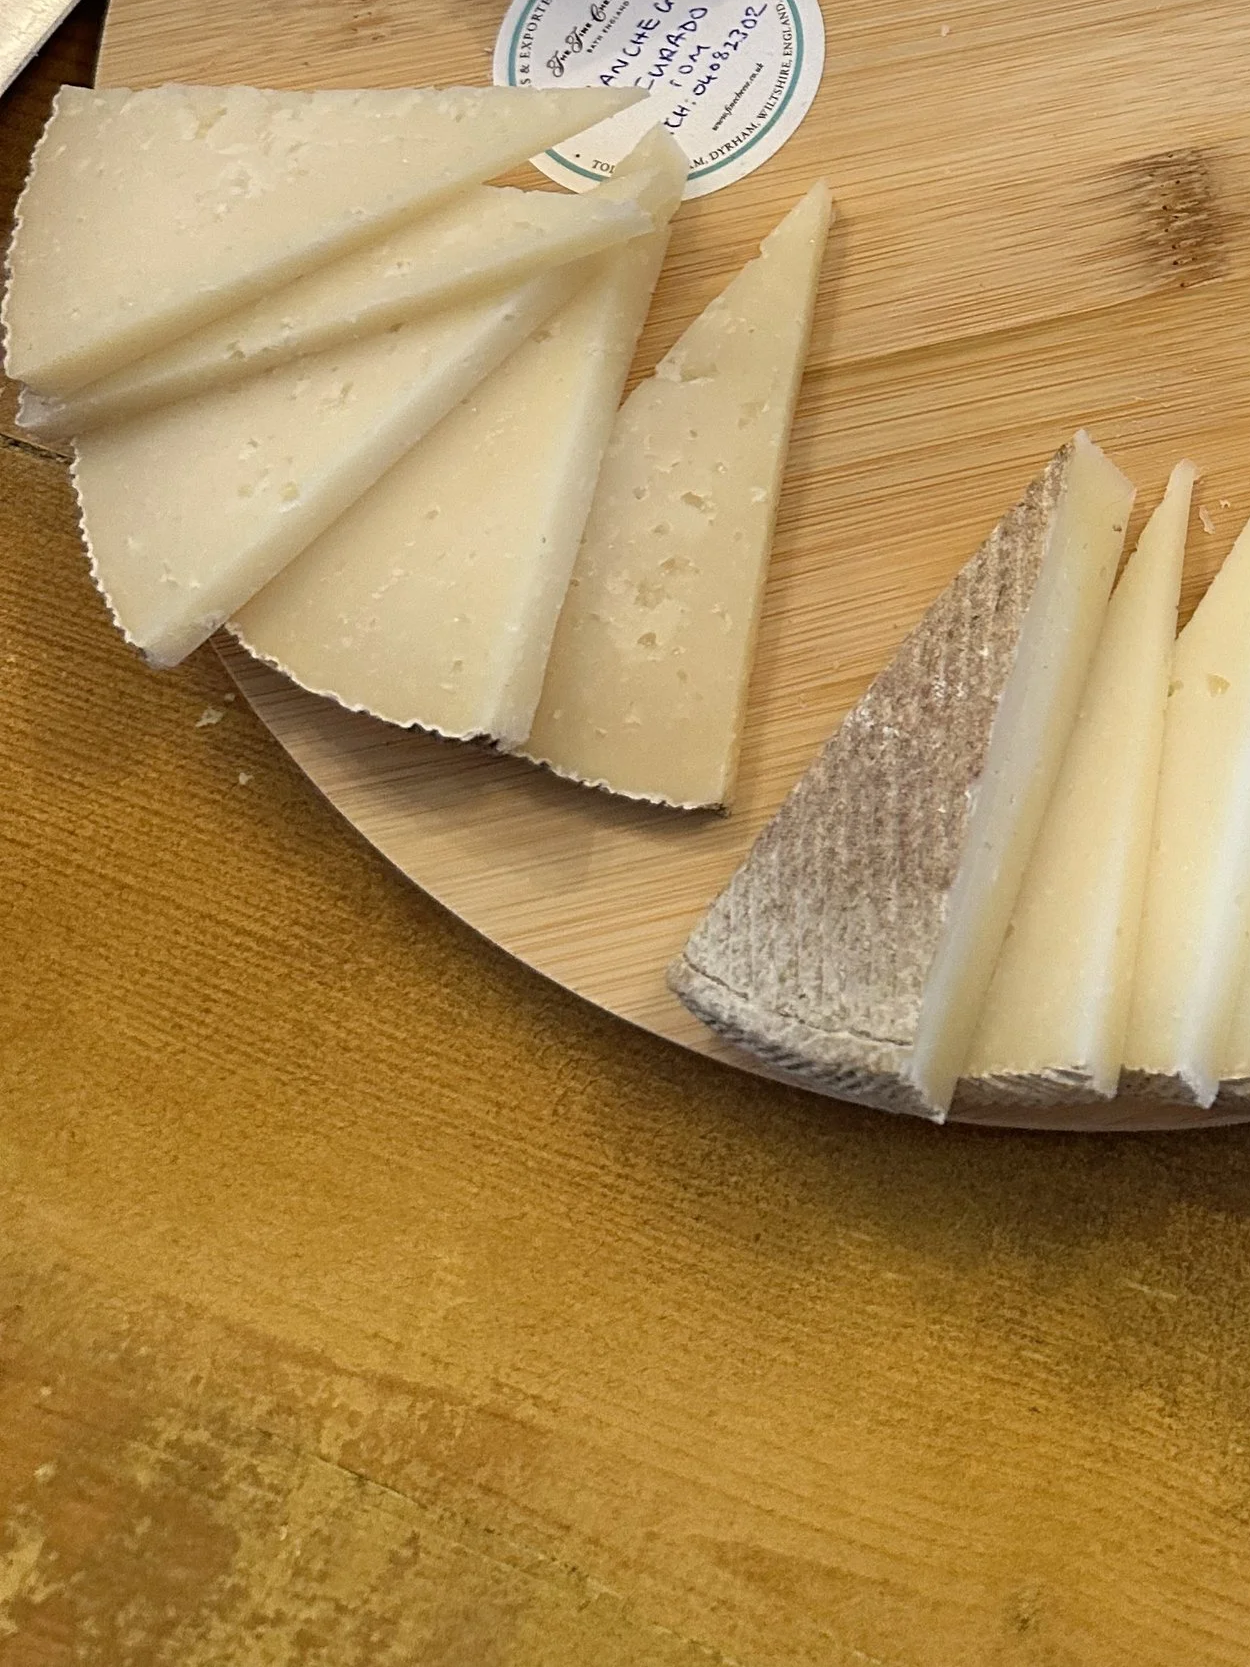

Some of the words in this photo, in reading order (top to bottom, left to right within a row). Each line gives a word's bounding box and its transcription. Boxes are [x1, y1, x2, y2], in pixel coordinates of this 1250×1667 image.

[586, 36, 603, 54] BATH
[602, 0, 630, 36] ENGLAND
[520, 63, 531, 74] &
